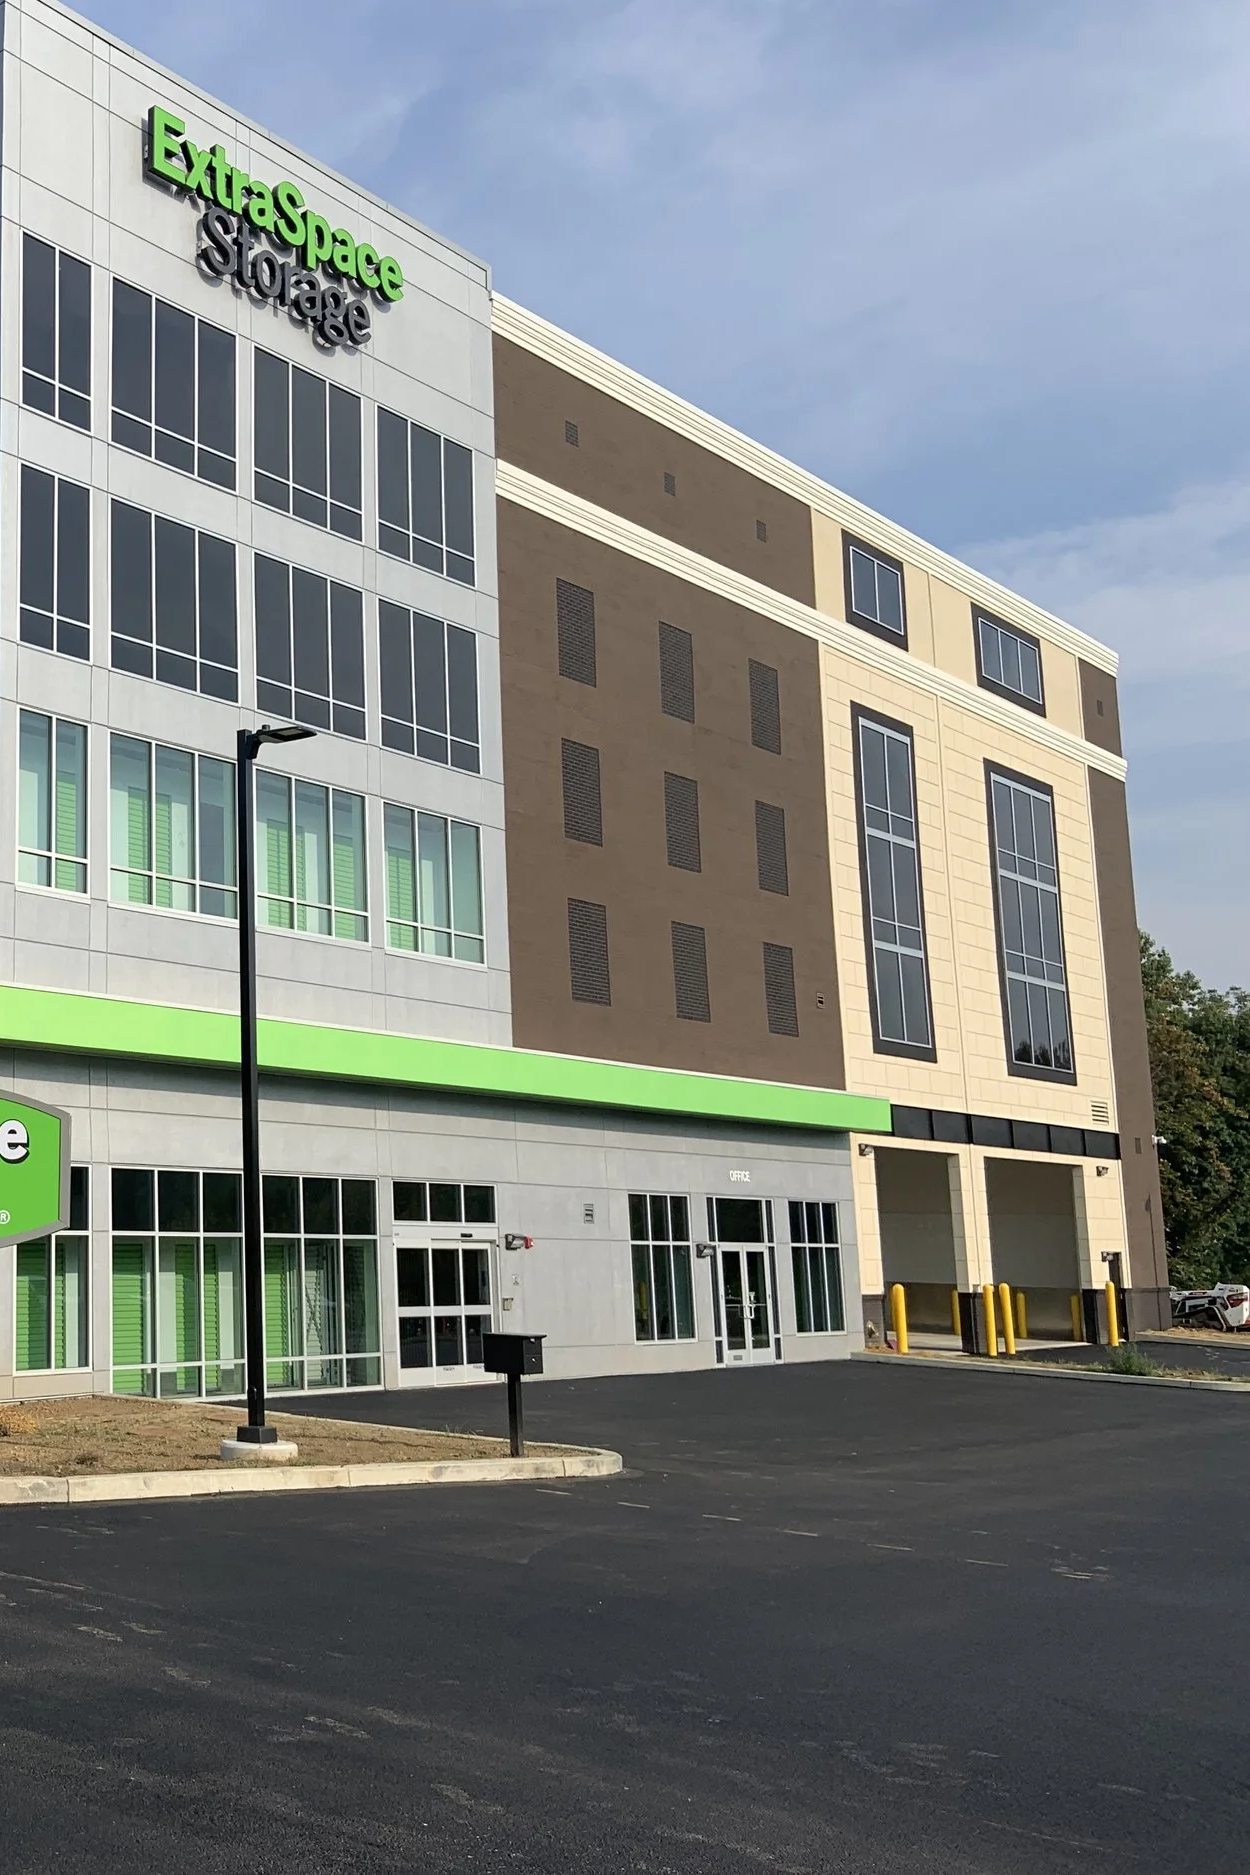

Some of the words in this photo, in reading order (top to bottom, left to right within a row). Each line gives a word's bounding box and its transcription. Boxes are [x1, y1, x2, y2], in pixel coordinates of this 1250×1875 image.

[148, 104, 404, 303] ExtraSpace
[197, 206, 372, 346] Storage
[729, 1169, 751, 1183] OFFICE
